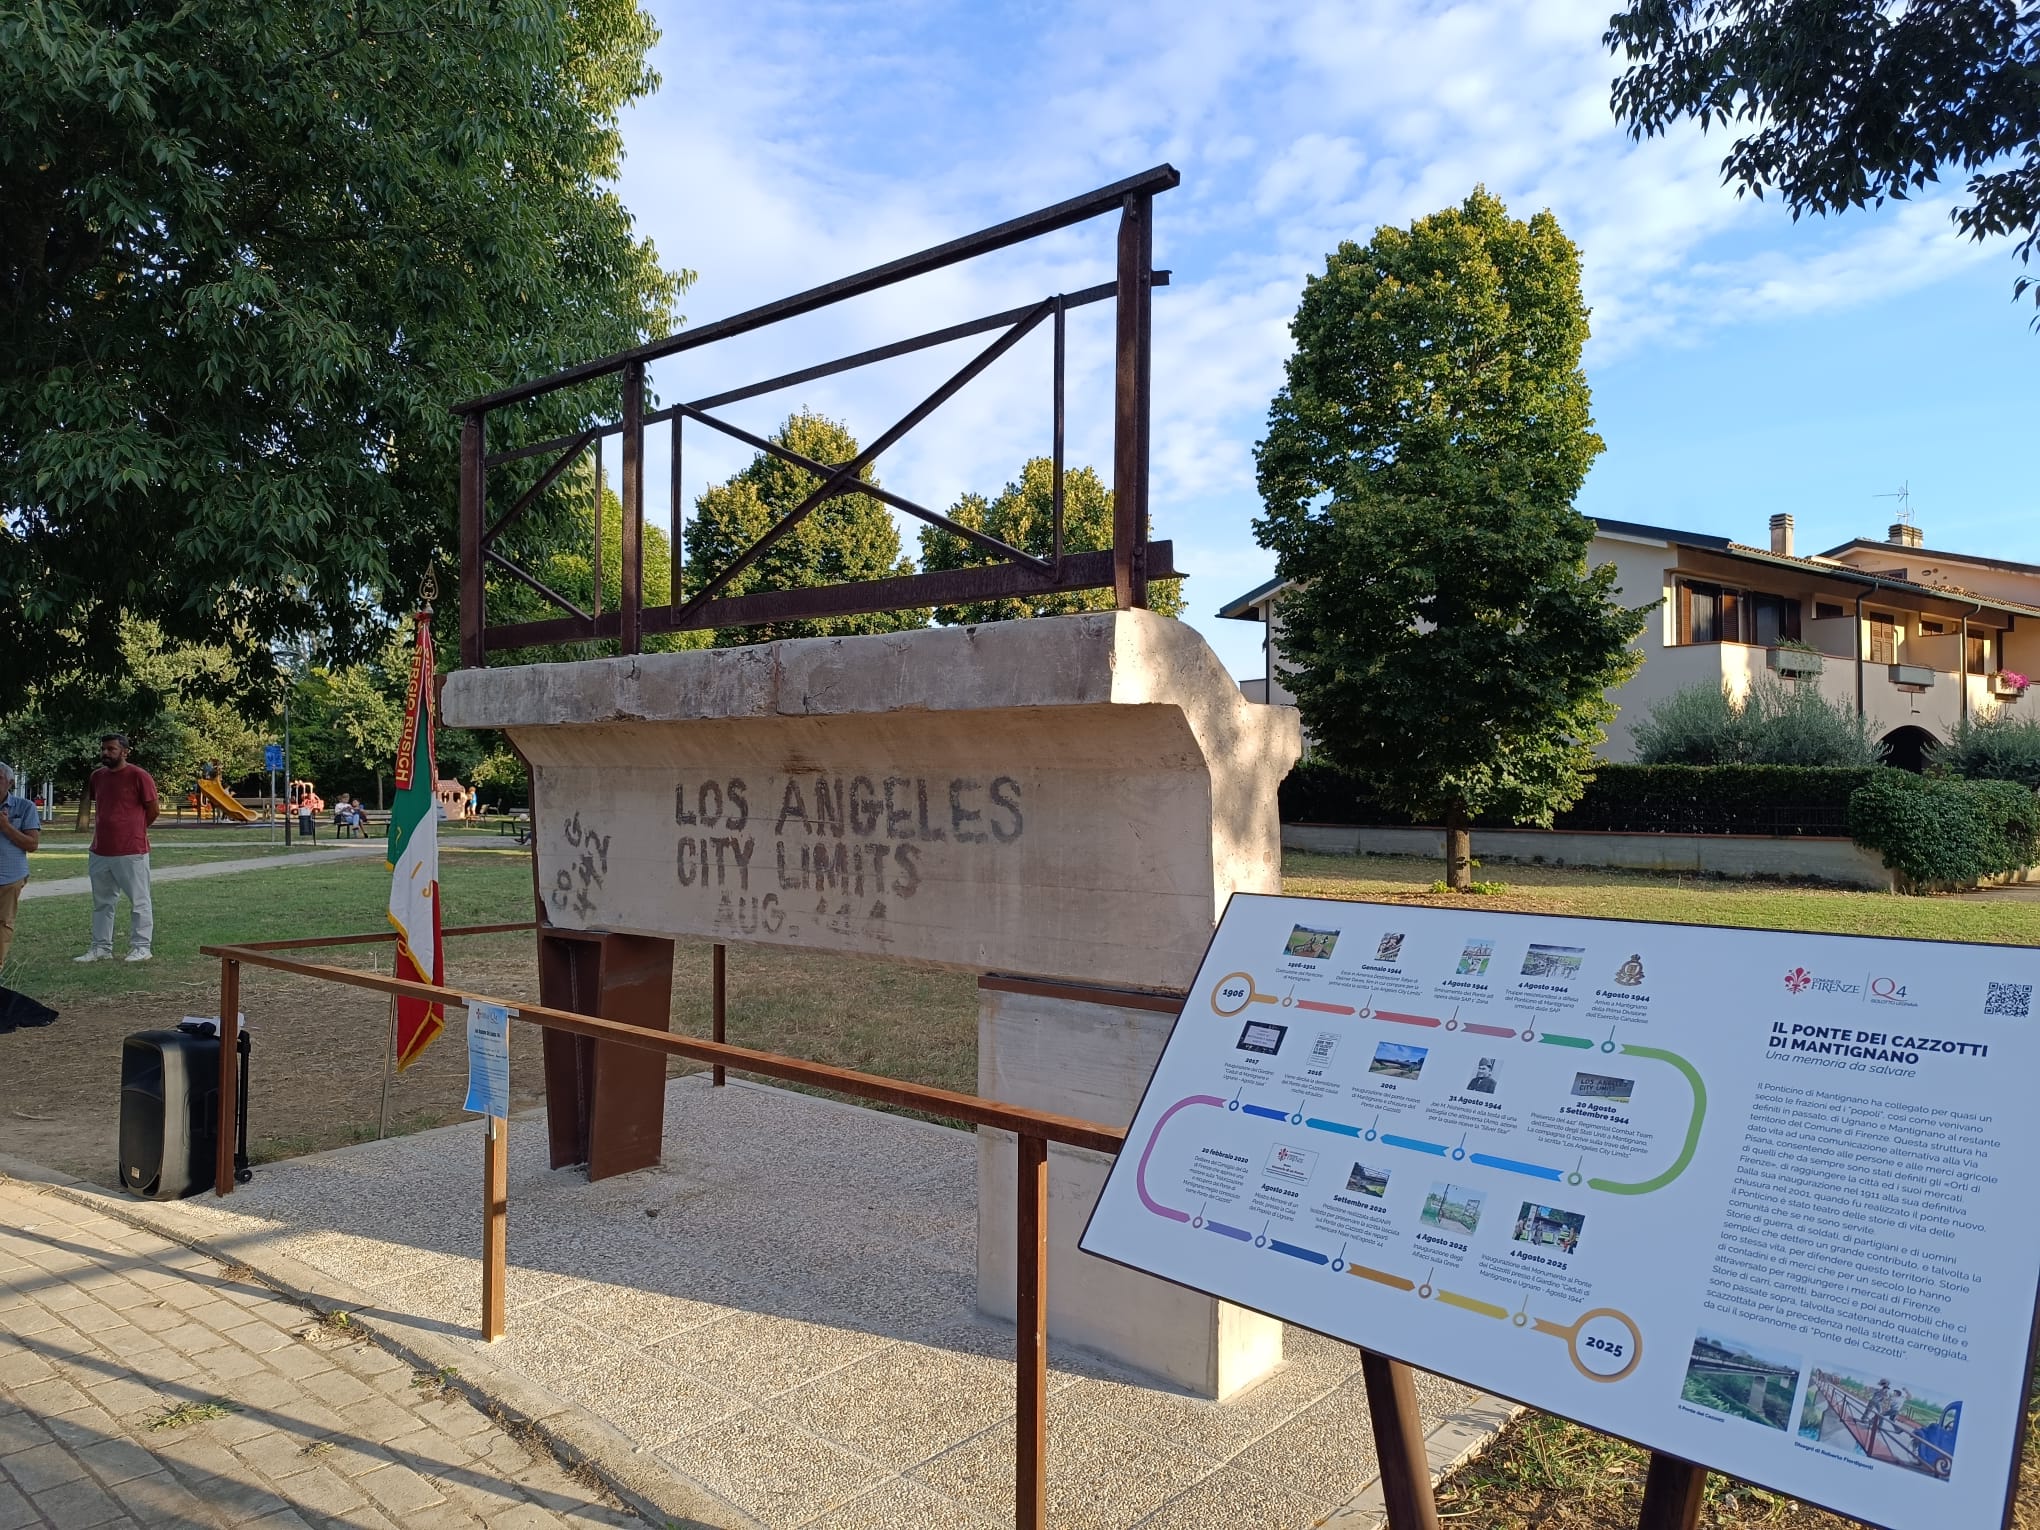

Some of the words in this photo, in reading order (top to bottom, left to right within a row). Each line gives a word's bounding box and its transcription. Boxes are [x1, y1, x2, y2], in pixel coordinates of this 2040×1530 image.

[408, 644, 423, 711] SERGIO
[396, 715, 414, 782] RUSICH
[675, 777, 748, 832] LOS
[774, 775, 1024, 844] ANGELES
[676, 836, 755, 891] CITY
[776, 840, 921, 898] LIMITS
[1361, 964, 1387, 973] Gennaio
[1386, 967, 1402, 975] 1944
[1222, 988, 1245, 998] 1906
[1447, 979, 1472, 988] Agosto
[1471, 983, 1489, 991] 1944
[1523, 981, 1550, 991] Agosto
[1550, 985, 1569, 994] 1944
[1811, 981, 1861, 994] FIRENZE
[1601, 990, 1630, 1000] Agosto
[1630, 994, 1650, 1003] 1944
[1768, 1035, 1788, 1049] DI
[1790, 1038, 1919, 1065] MANTIGNANO
[1772, 1021, 1788, 1035] IL
[1791, 1023, 1853, 1042] PONTE
[1855, 1031, 1887, 1046] DEI
[1891, 1035, 1988, 1058] CAZZOTTI
[1244, 1057, 1260, 1066] 2017
[1765, 1049, 1791, 1062] Una
[1791, 1055, 1847, 1069] memoria
[1848, 1061, 1867, 1072] da
[1868, 1065, 1916, 1078] salvare
[1380, 1082, 1397, 1091] 2001
[1457, 1095, 1484, 1106] Agosto
[1484, 1101, 1502, 1111] 1944
[1575, 1101, 1587, 1109] 20
[1587, 1102, 1617, 1114] Agosto
[1757, 1082, 1763, 1090] Il
[1763, 1082, 1804, 1096] Ponticino
[1804, 1089, 1815, 1097] di
[1815, 1090, 1870, 1105] Mantignano
[1870, 1098, 1883, 1107] ha
[1884, 1102, 1930, 1114] collegato
[1930, 1108, 1949, 1117] per
[1949, 1111, 1977, 1121] quasi
[1979, 1115, 1993, 1123] un
[1559, 1106, 1565, 1114] 5
[1565, 1106, 1609, 1121] Settembre
[1609, 1115, 1630, 1125] 1944
[1746, 1123, 1768, 1133] dato
[1768, 1127, 1784, 1136] vita
[1785, 1130, 1798, 1139] ad
[1798, 1133, 1816, 1142] una
[1817, 1136, 1888, 1154] comunicazione
[1888, 1147, 1941, 1163] alternativa
[1942, 1156, 1961, 1166] alla
[1962, 1158, 1979, 1169] Via
[1749, 1113, 1787, 1126] territorio
[1787, 1119, 1803, 1129] del
[1803, 1121, 1843, 1135] Comune
[1843, 1128, 1854, 1137] di
[1893, 1135, 1929, 1149] Questa
[1930, 1142, 1973, 1156] struttura
[1975, 1148, 1988, 1158] ha
[1775, 1140, 1836, 1156] consentendo
[1836, 1150, 1854, 1160] alle
[1855, 1154, 1895, 1167] persone
[1905, 1161, 1924, 1172] alle
[1925, 1165, 1955, 1177] merci
[1955, 1171, 1999, 1184] agricole
[1260, 1183, 1283, 1194] Agosto
[1282, 1189, 1299, 1198] 2020
[1733, 1177, 1771, 1190] chiusura
[1772, 1185, 1787, 1194] nel
[1813, 1193, 1850, 1206] quando
[1851, 1198, 1862, 1208] fu
[1863, 1202, 1911, 1218] realizzato
[1912, 1210, 1918, 1219] il
[1919, 1213, 1950, 1225] ponte
[1736, 1165, 1759, 1177] Dalla
[1760, 1171, 1777, 1180] sua
[1777, 1174, 1842, 1192] inaugurazione
[1843, 1187, 1859, 1196] nel
[1860, 1189, 1880, 1200] 1911
[1881, 1193, 1900, 1203] alla
[1901, 1198, 1920, 1207] sua
[1921, 1200, 1967, 1216] definitiva
[1332, 1194, 1369, 1209] Settembre
[1368, 1204, 1387, 1214] 2020
[1421, 1233, 1449, 1246] Agosto
[1448, 1241, 1468, 1253] 2025
[1509, 1249, 1516, 1257] 4
[1516, 1250, 1546, 1264] Agosto
[1546, 1258, 1568, 1271] 2025
[1703, 1299, 1716, 1310] da
[1716, 1304, 1731, 1314] cui
[1731, 1306, 1738, 1316] il
[1738, 1310, 1798, 1331] soprannome
[1798, 1325, 1809, 1334] di
[1843, 1336, 1860, 1348] dei
[1709, 1277, 1732, 1289] sono
[1731, 1283, 1769, 1298] passate
[1800, 1299, 1835, 1315] talvolta
[1837, 1309, 1896, 1330] scatenando
[1897, 1324, 1940, 1341] qualche
[1942, 1333, 1959, 1345] lite
[1960, 1340, 1969, 1348] e
[1585, 1336, 1623, 1358] 2025
